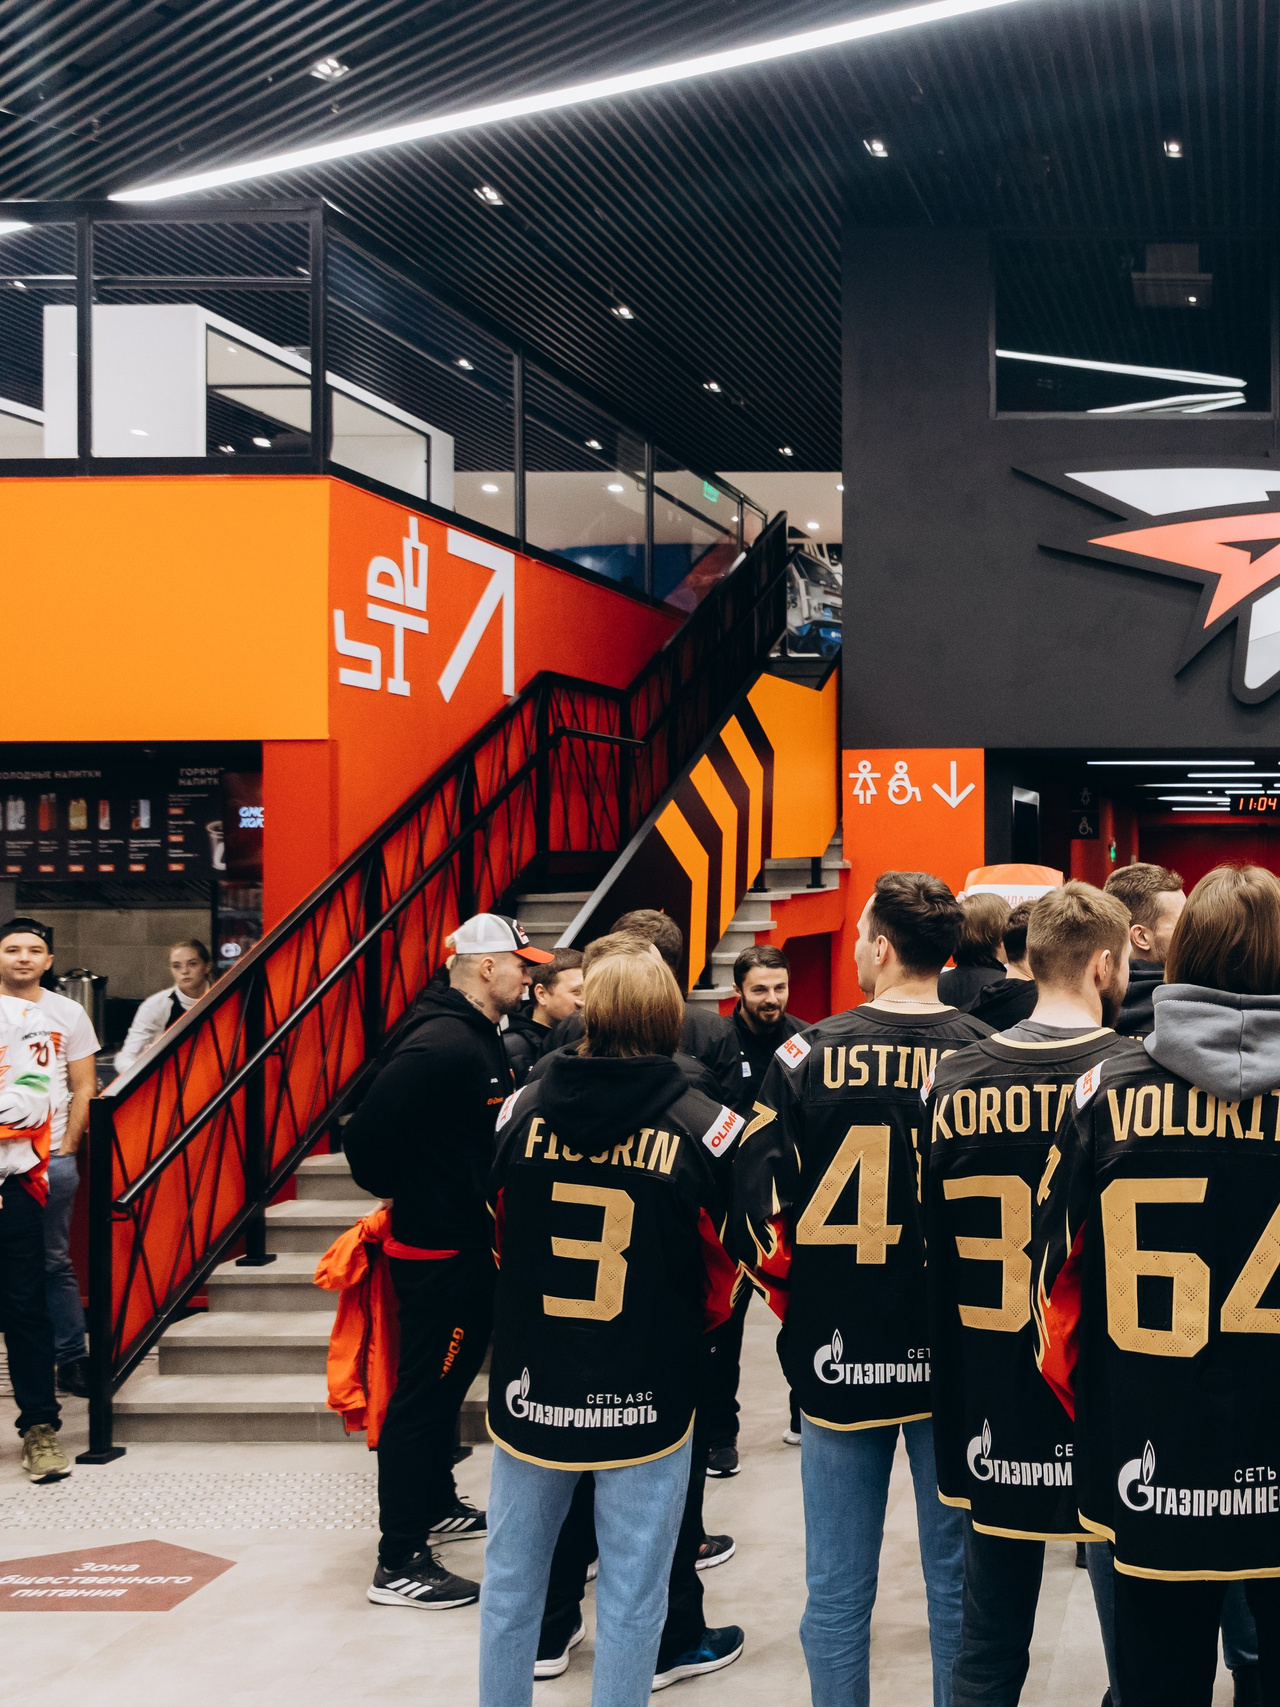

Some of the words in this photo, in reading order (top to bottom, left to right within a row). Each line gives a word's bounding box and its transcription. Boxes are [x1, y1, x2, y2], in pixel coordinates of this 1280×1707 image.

[54, 769, 102, 779] НАПИТКИ
[1239, 797, 1277, 811] 11:04
[823, 1044, 957, 1089] USTIN
[796, 1125, 919, 1264] 4
[543, 1181, 636, 1322] 3
[586, 1393, 622, 1405] СЕТЬ
[625, 1391, 653, 1404] АЗС
[528, 1401, 658, 1428] ГАЗПРОМНЕФТЬ
[1234, 1466, 1277, 1483] СЕТЬ
[73, 1561, 141, 1573] Зона
[9, 1587, 129, 1598] питания
